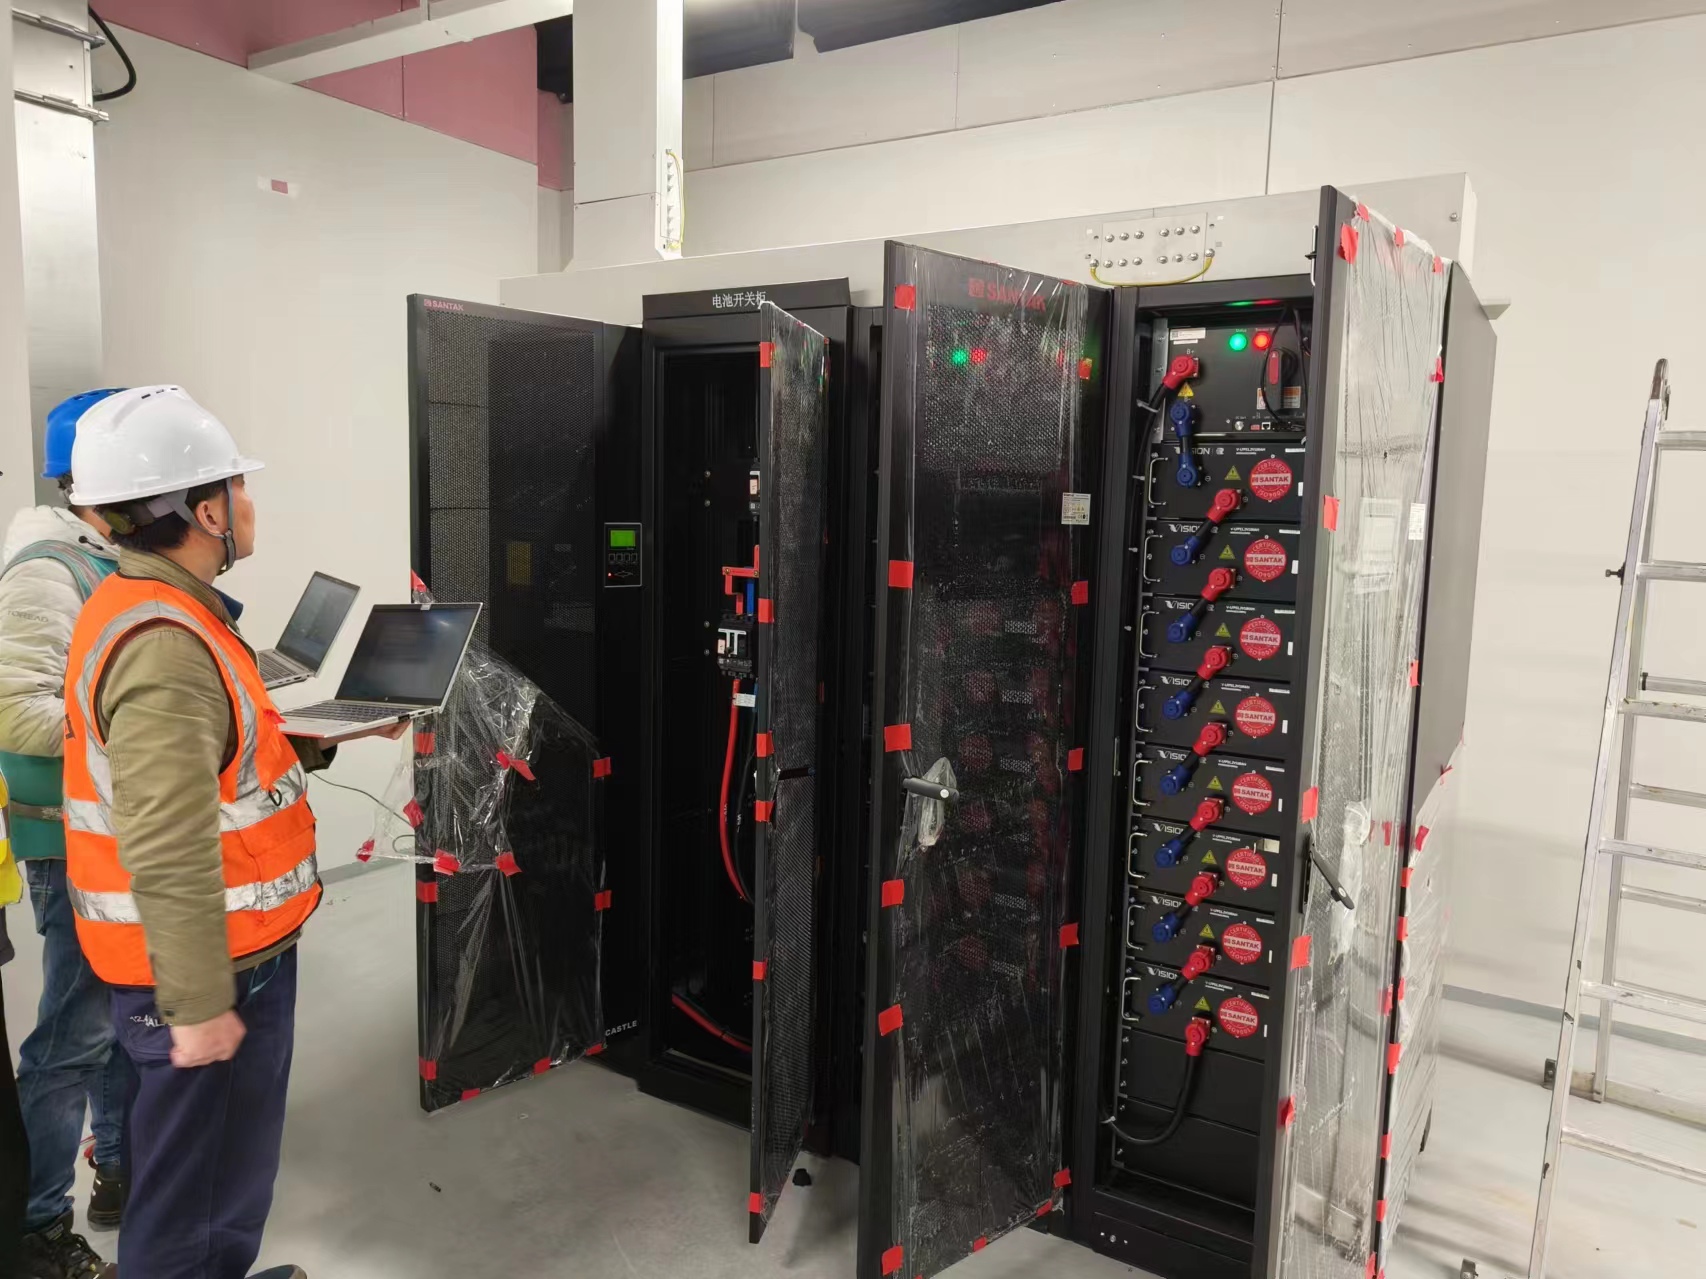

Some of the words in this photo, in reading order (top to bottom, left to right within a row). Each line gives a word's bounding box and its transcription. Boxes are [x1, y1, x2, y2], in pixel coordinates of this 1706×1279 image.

[1259, 475, 1289, 483] SANTAK
[1249, 635, 1278, 643] SANTAK
[1244, 713, 1273, 721] SANTAK
[1241, 790, 1269, 799] SANTAK
[1235, 864, 1264, 874] SANTAK
[1231, 940, 1259, 950] SANTAK
[1227, 1013, 1256, 1024] SANTAK
[605, 1020, 637, 1036] CASTLE
